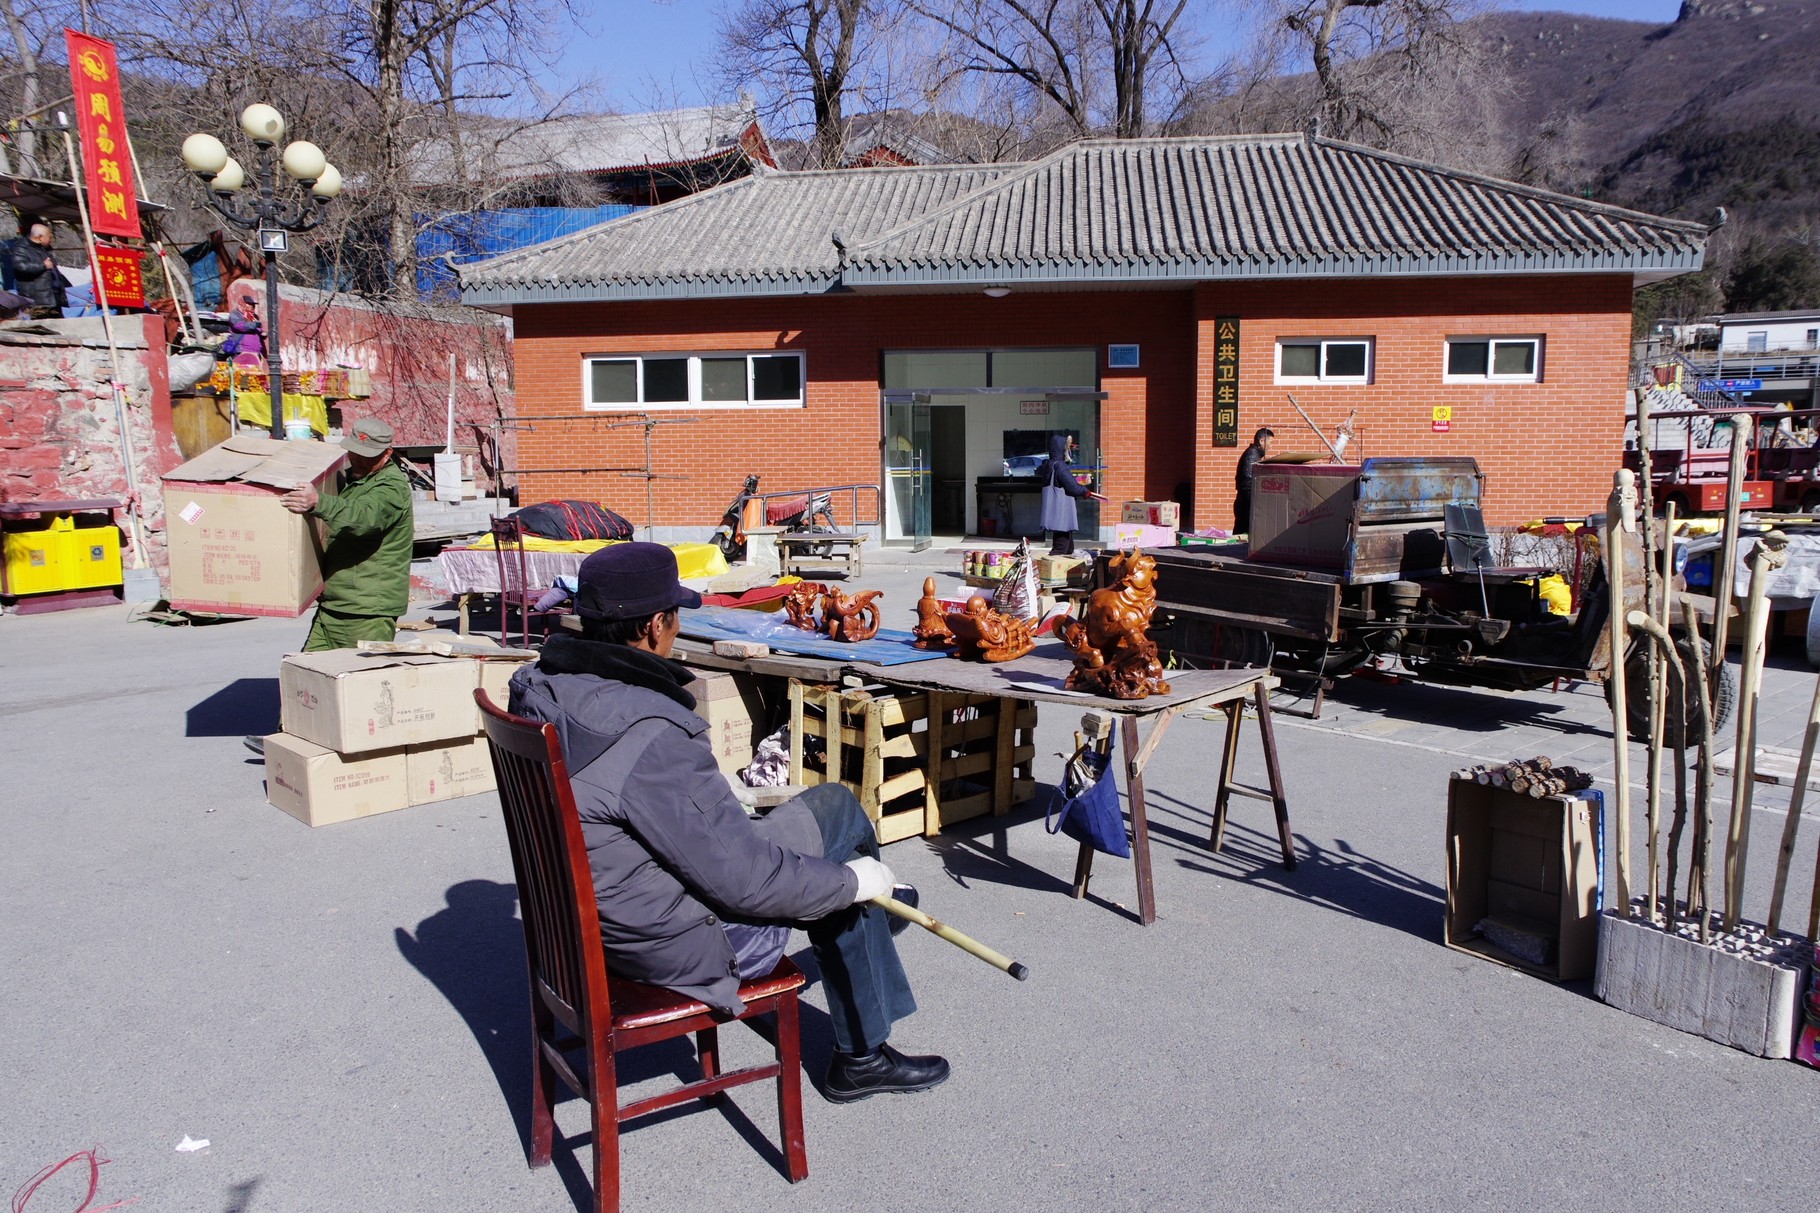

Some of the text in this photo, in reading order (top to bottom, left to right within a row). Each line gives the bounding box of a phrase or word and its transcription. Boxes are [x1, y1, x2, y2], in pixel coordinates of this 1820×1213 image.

[90, 92, 127, 221] 周易预测
[1217, 322, 1236, 427] 公共卫生间
[1215, 432, 1237, 440] TOILET
[333, 775, 346, 783] ITEM
[334, 783, 346, 791] ITEM
